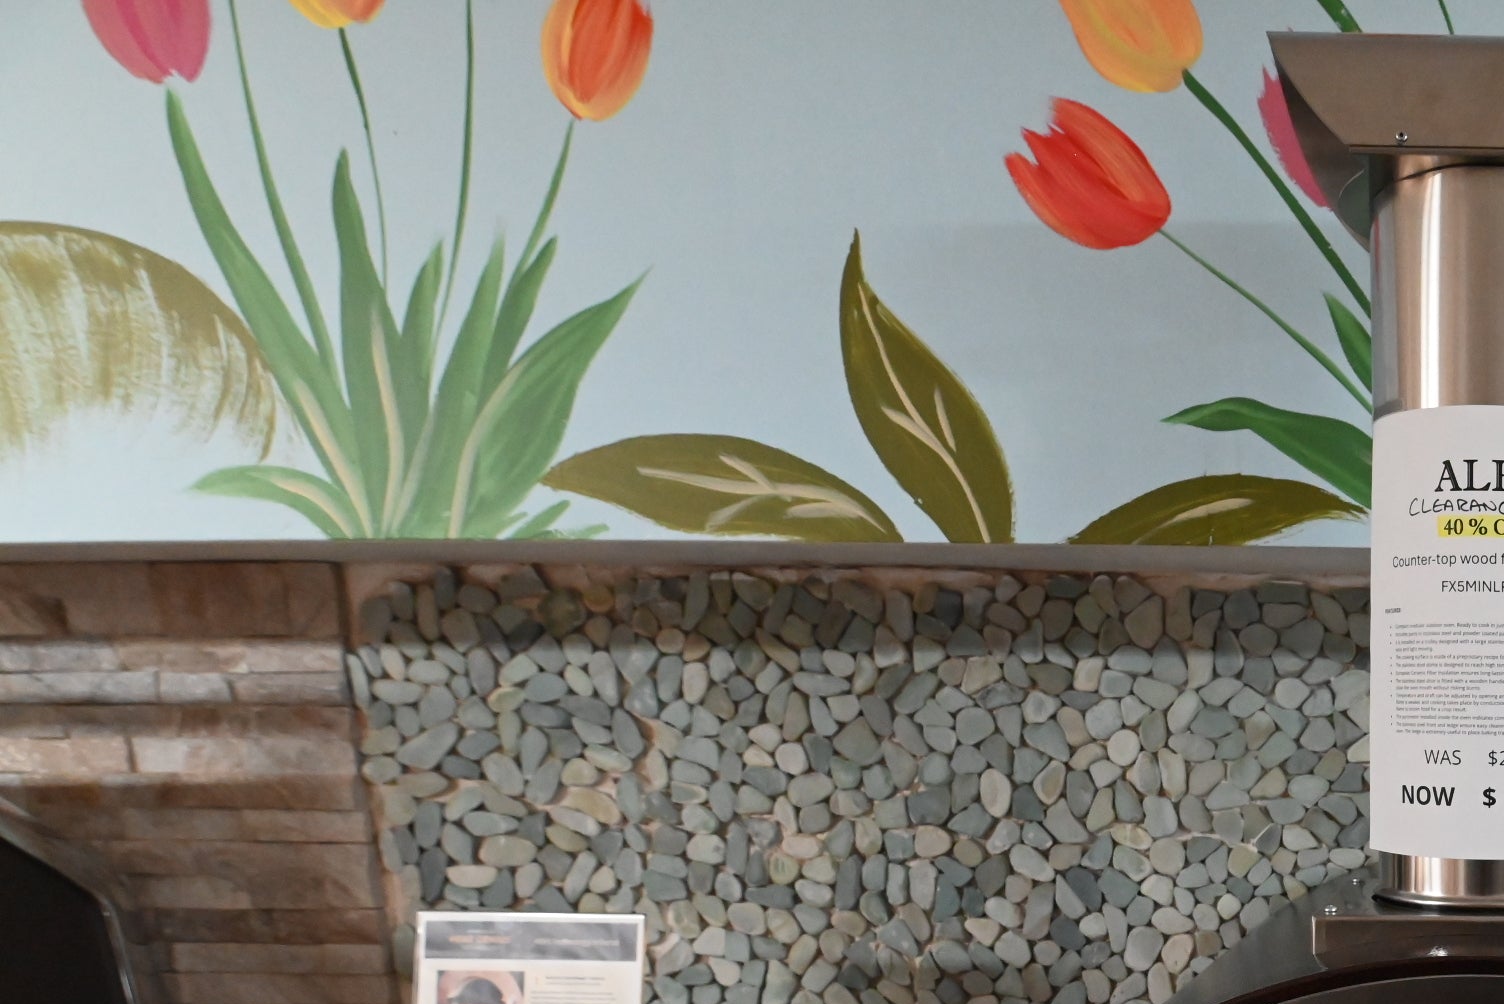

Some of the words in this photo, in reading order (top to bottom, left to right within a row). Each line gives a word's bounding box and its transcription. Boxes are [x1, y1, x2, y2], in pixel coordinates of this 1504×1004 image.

[1443, 519, 1464, 535] 40
[1392, 553, 1456, 568] Counter-top
[1460, 553, 1497, 565] wood
[1424, 749, 1462, 765] WAS
[1402, 784, 1455, 806] NOW
